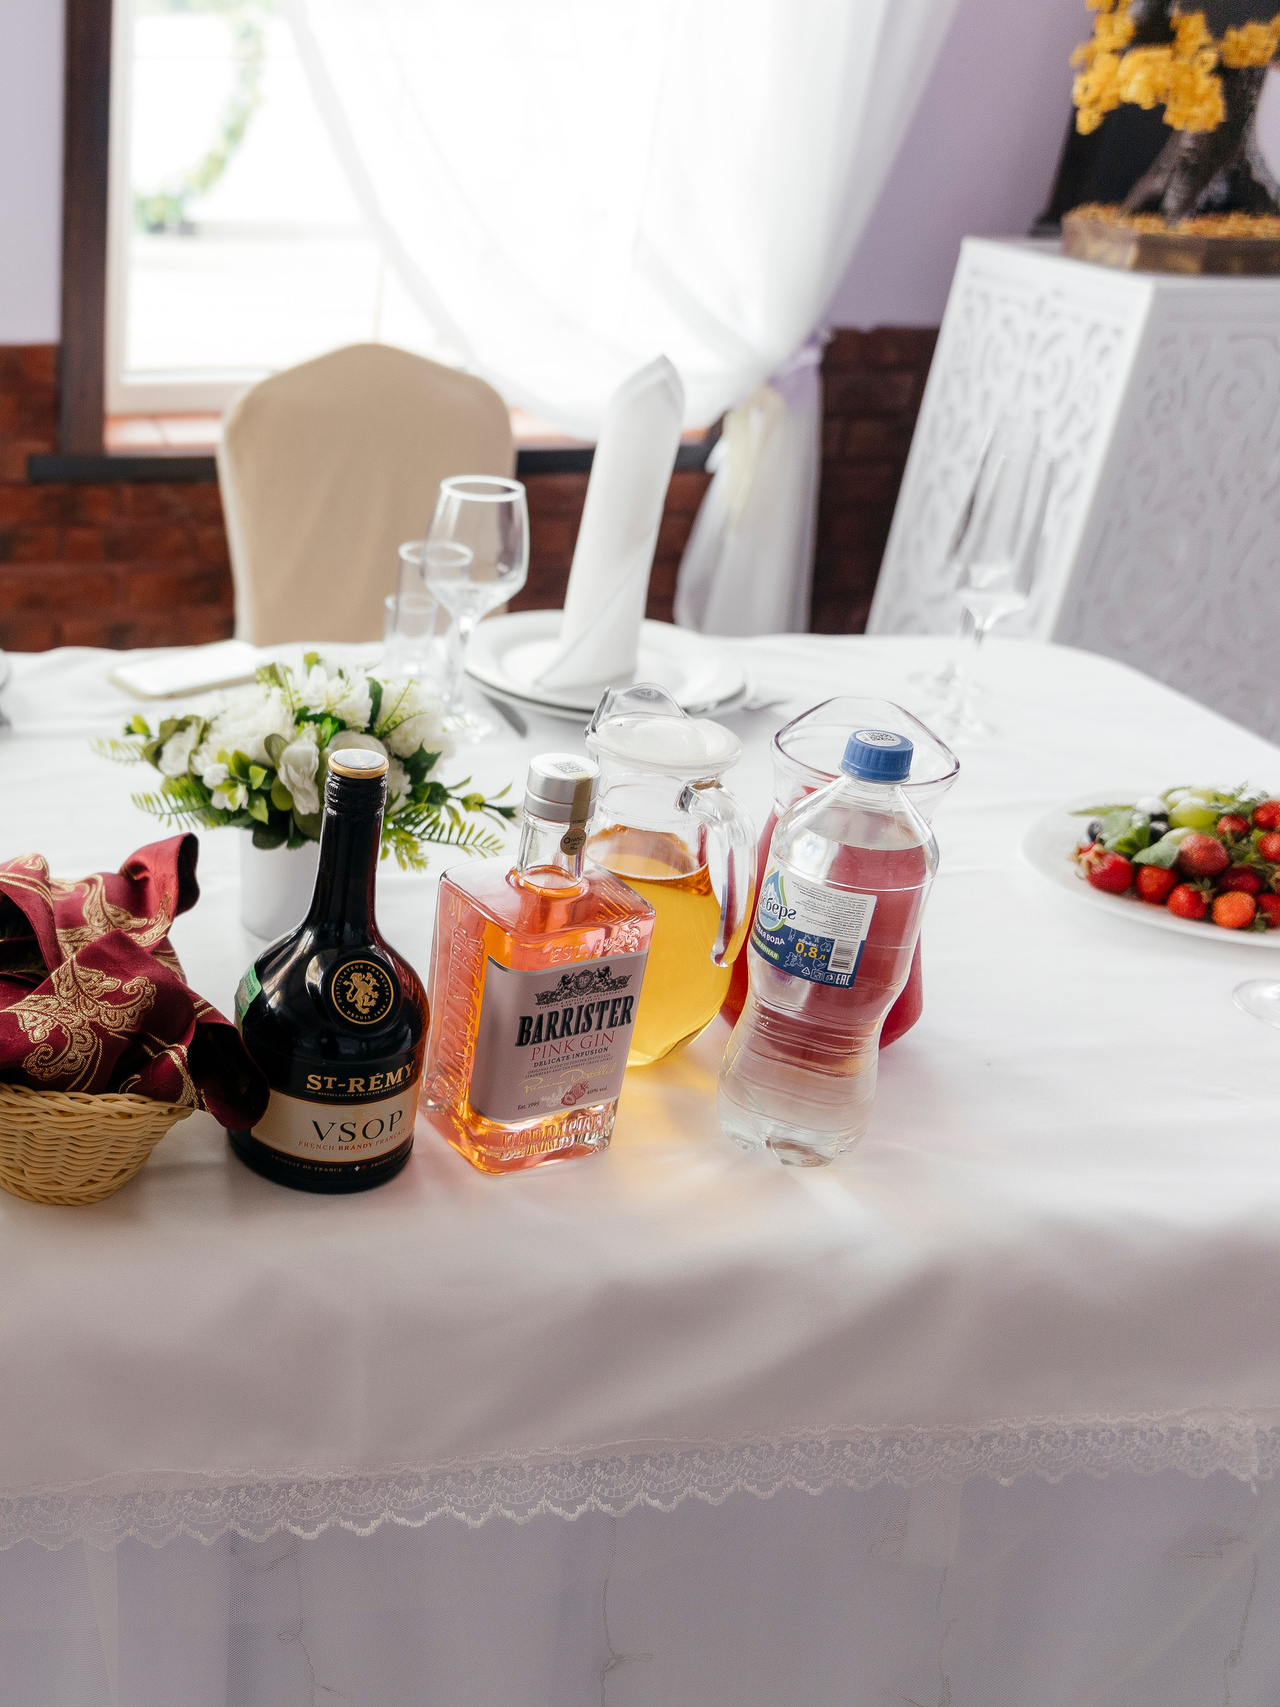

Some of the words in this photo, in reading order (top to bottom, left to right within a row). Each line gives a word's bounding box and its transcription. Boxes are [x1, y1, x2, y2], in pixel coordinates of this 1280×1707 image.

[766, 933, 786, 945] ВОДА
[795, 942, 818, 959] 0,8
[336, 964, 363, 1003] DISTILLATEUR
[515, 995, 634, 1047] BARRISTER
[531, 1038, 575, 1061] PINK
[580, 1030, 615, 1049] GIN
[533, 1054, 570, 1067] DELICATE
[572, 1046, 609, 1059] INFUSION
[306, 1060, 414, 1093] ST-RÉMY
[312, 1110, 403, 1143] VSOP
[298, 1140, 334, 1151] FRENCH
[338, 1141, 374, 1151] BRANDY
